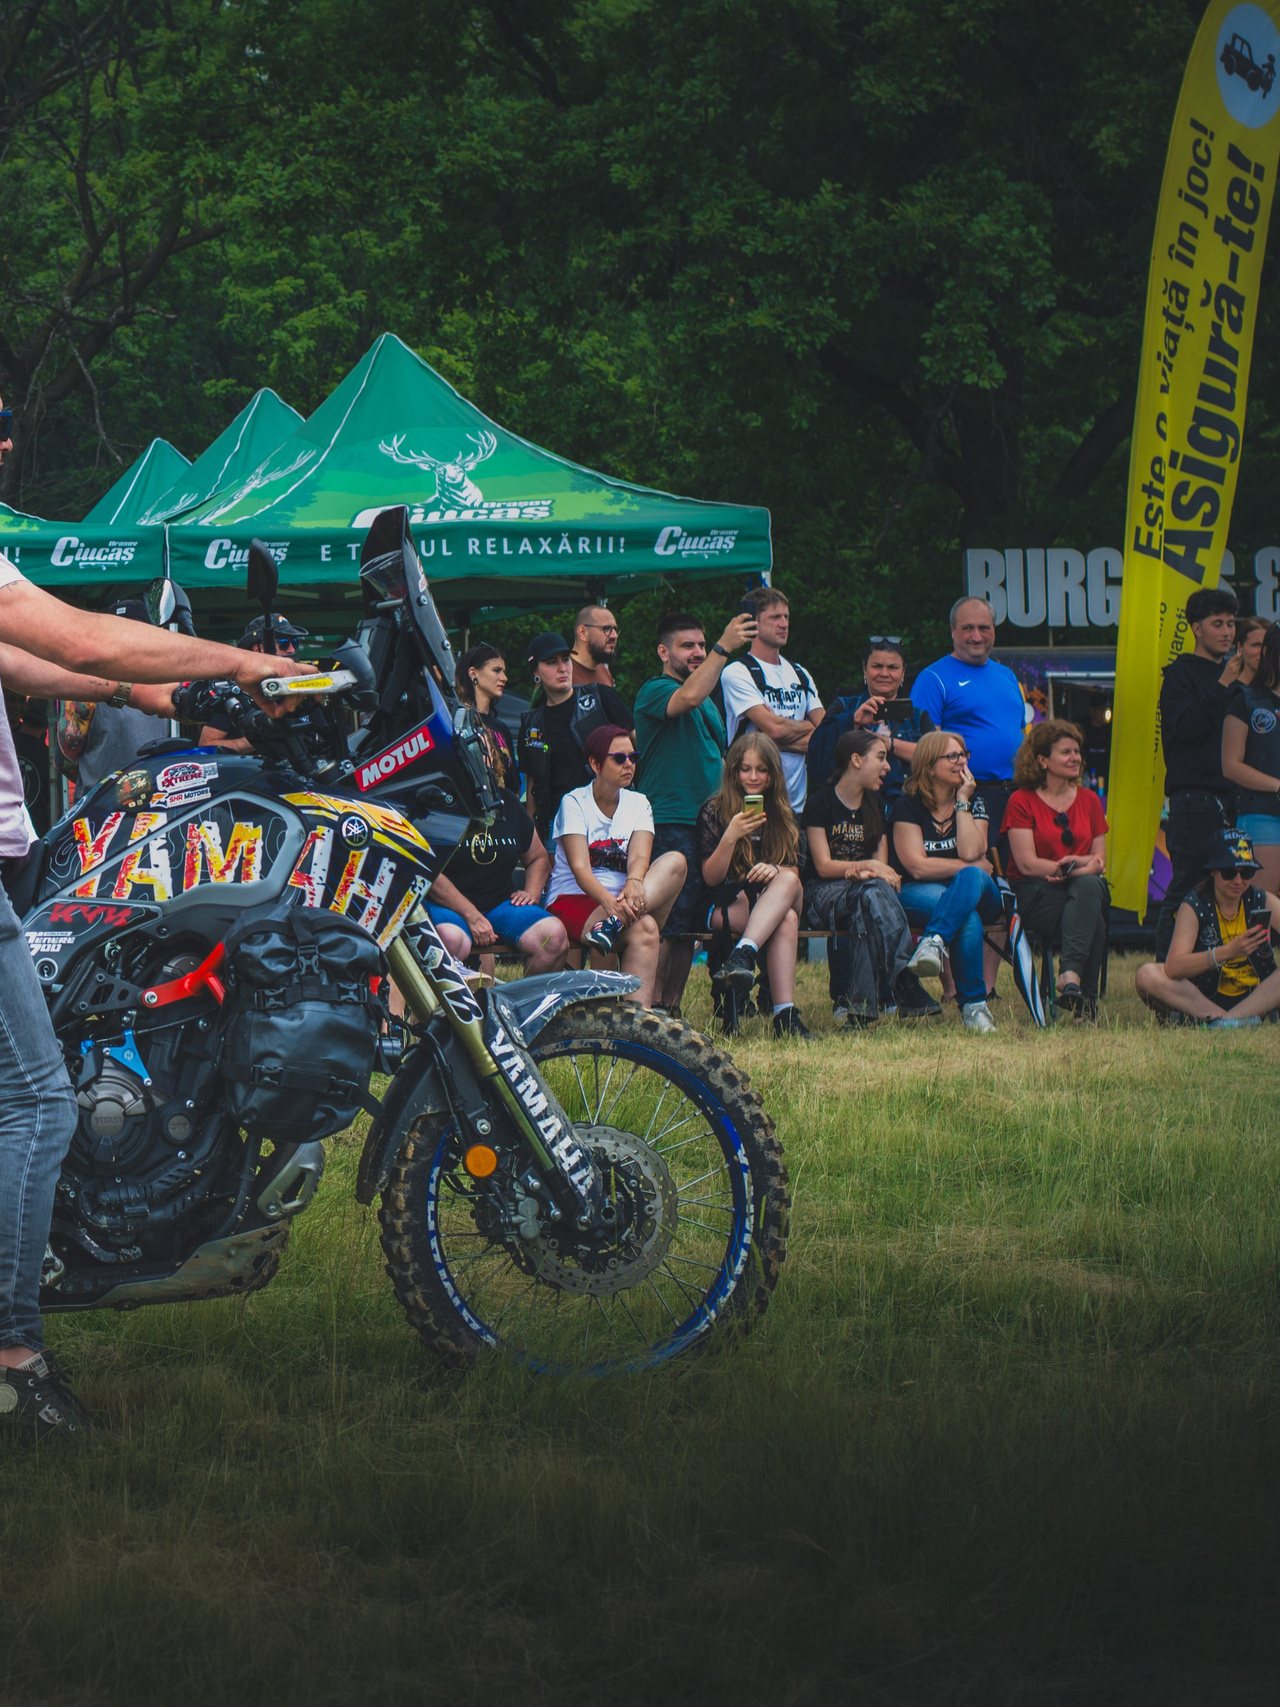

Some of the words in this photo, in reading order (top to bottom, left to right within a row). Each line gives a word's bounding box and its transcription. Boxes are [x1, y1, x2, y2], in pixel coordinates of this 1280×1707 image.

[1178, 117, 1216, 220] joc!
[1168, 221, 1200, 270] în
[1162, 142, 1266, 586] Asigură-te!
[1133, 455, 1167, 561] Este
[50, 536, 136, 567] Ciucaș
[204, 539, 287, 569] Ciuș
[467, 532, 626, 556] RELAXĂRII!
[765, 690, 802, 704] THAPY
[361, 732, 430, 788] MOTUL
[161, 769, 204, 789] EXTREME
[184, 788, 210, 799] MOTORS
[843, 833, 865, 842] 2025
[489, 1027, 596, 1198] YAMAHA
